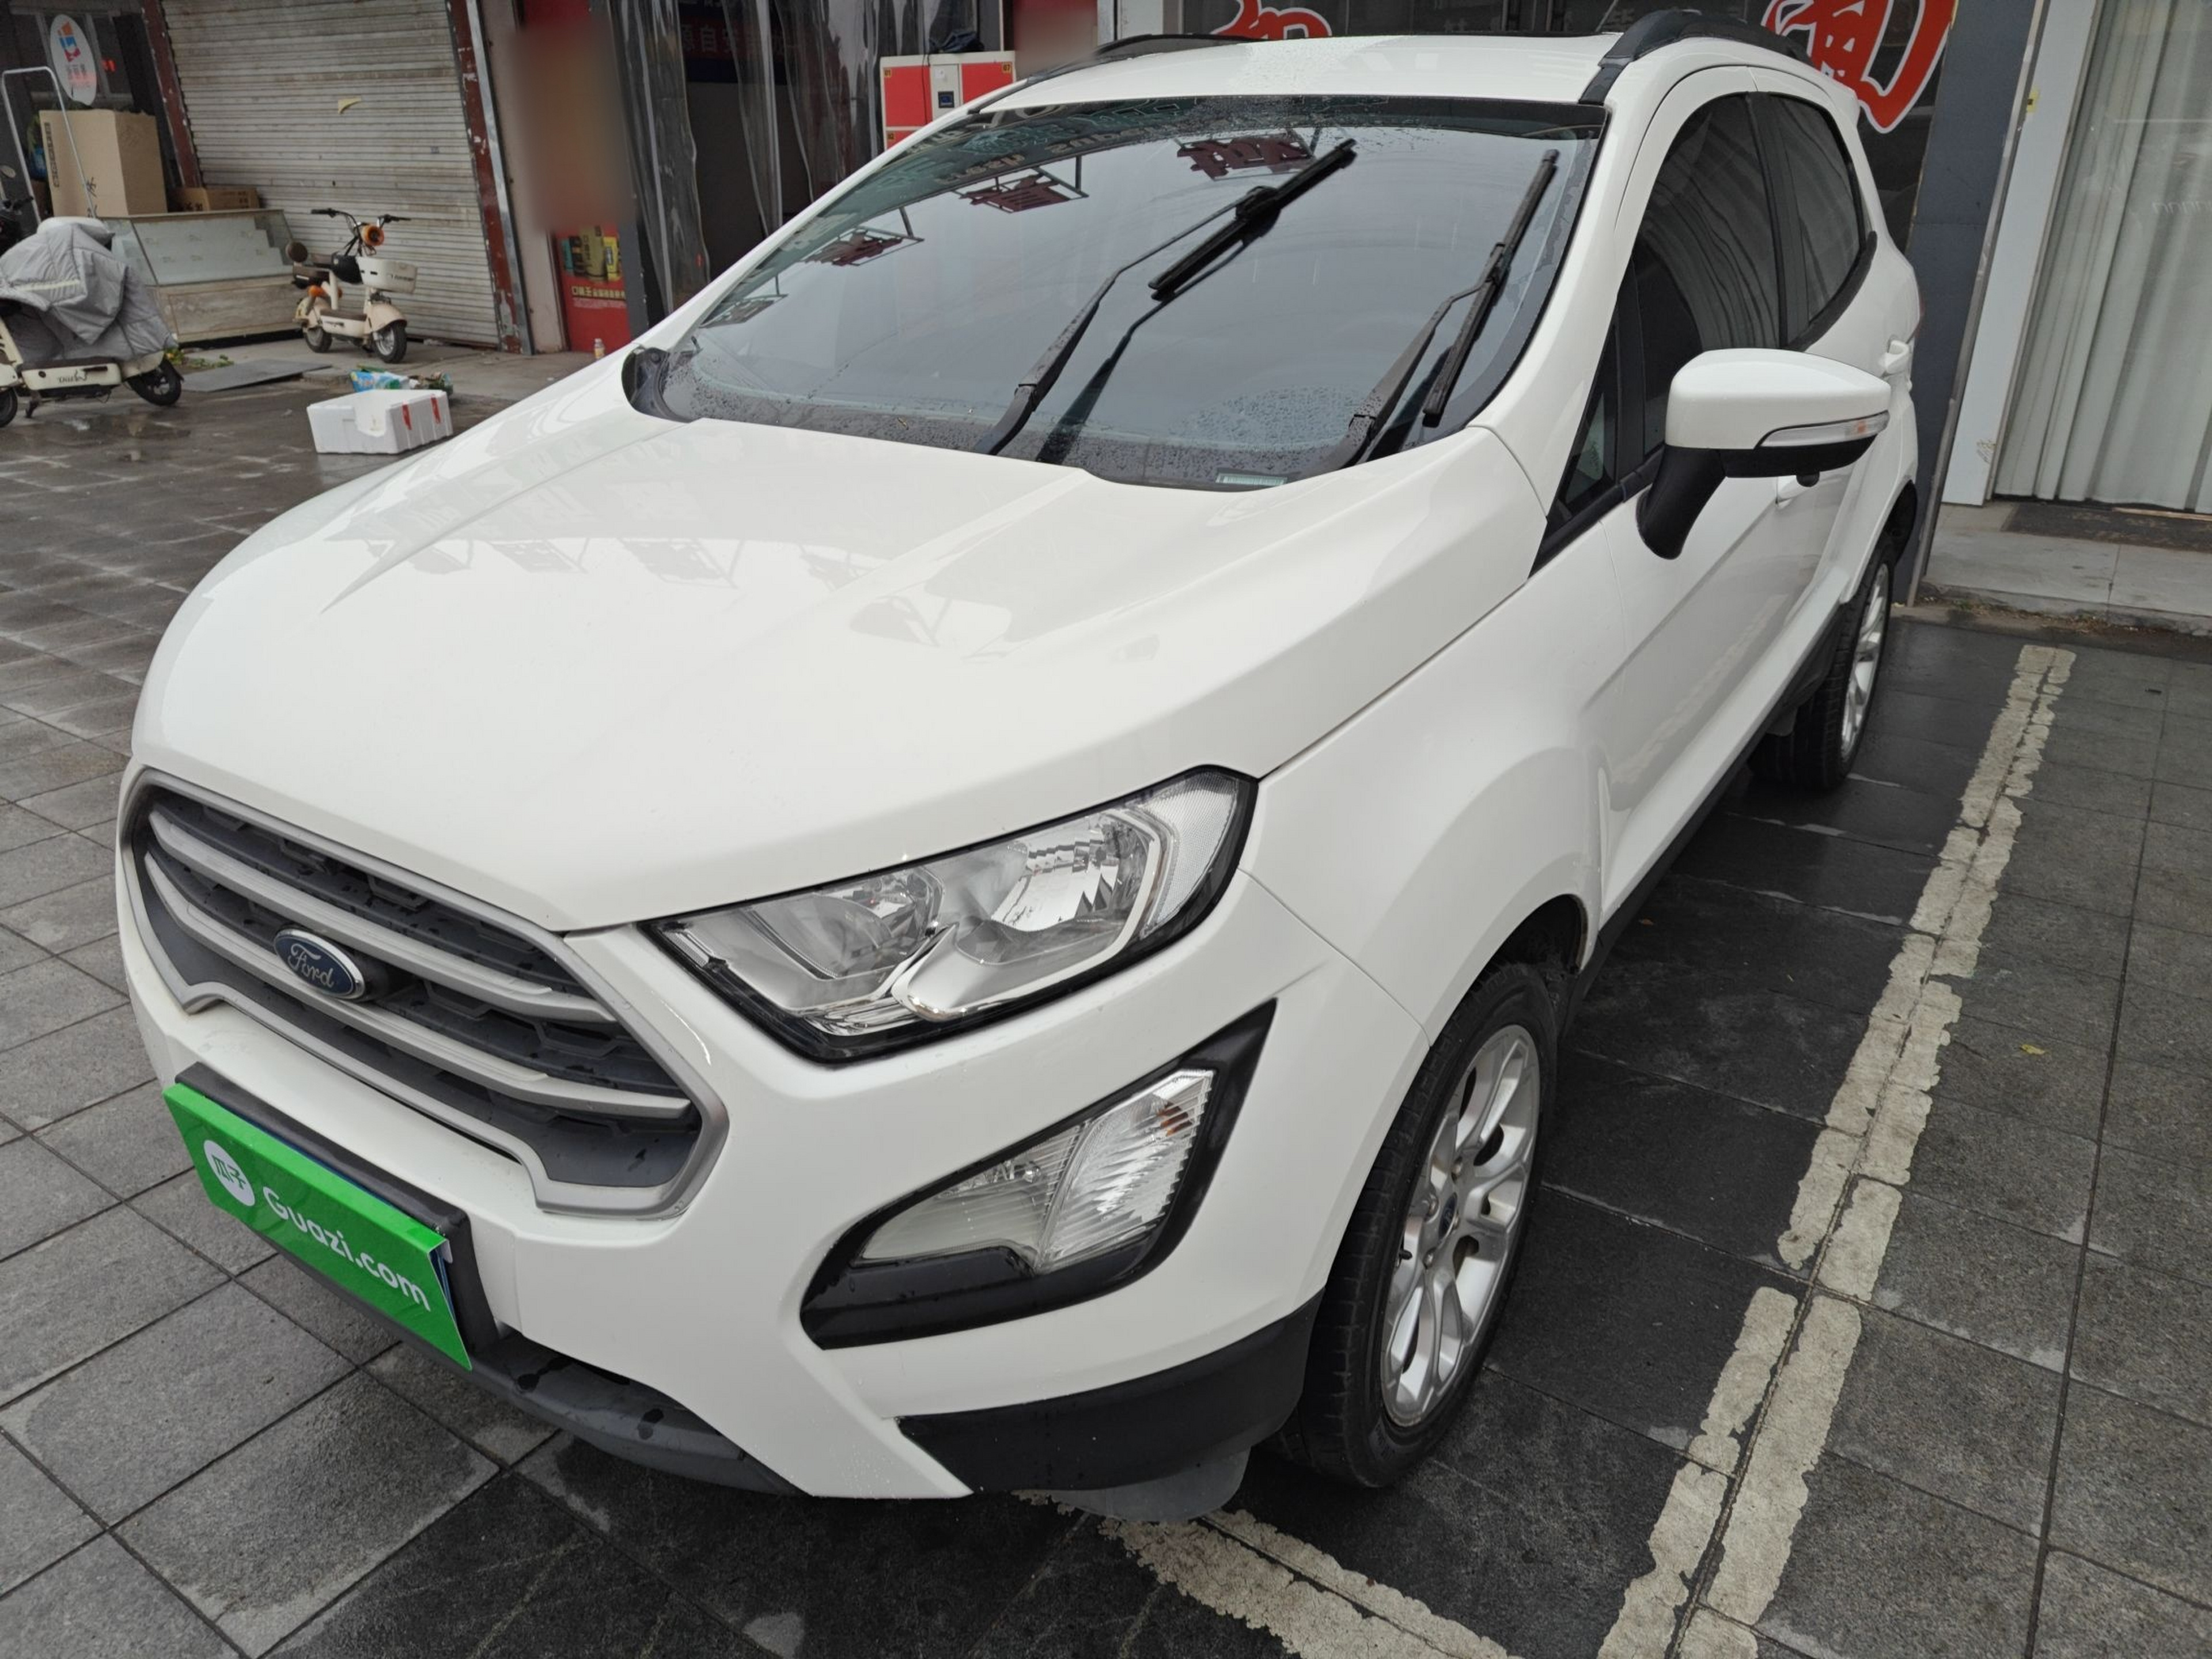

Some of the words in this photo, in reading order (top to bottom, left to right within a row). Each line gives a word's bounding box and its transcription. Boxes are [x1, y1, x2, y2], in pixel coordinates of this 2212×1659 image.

[287, 943, 335, 988] Ford
[211, 1154, 246, 1190] 瓜子
[263, 1186, 430, 1312] Guazi.com
